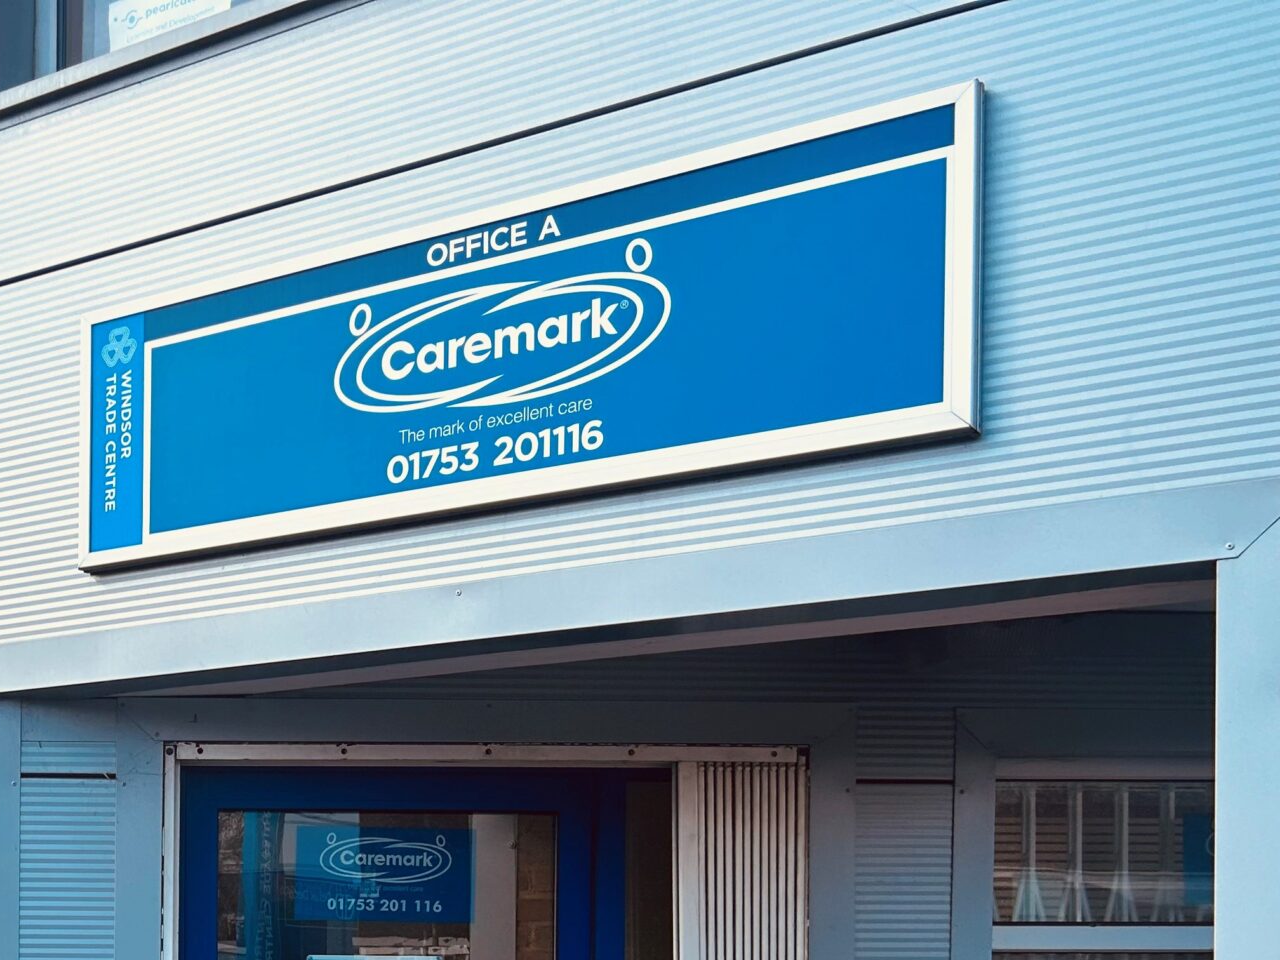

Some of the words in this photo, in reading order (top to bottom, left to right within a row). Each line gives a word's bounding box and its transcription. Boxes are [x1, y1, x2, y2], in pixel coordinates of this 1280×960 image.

[426, 221, 527, 266] OFFICE
[538, 214, 561, 241] A
[381, 297, 619, 381] Caremark
[105, 373, 117, 435] TRADE
[120, 369, 132, 459] WINDSOR
[399, 428, 425, 445] The
[429, 420, 465, 440] mark
[468, 415, 484, 432] of
[486, 404, 554, 428] excellent
[558, 398, 593, 415] care
[104, 440, 116, 512] CENTRE
[386, 441, 480, 484] 01753
[493, 419, 604, 467] 201116
[340, 850, 433, 867] Caremark
[327, 898, 375, 911] 01753
[380, 899, 407, 912] 201
[414, 900, 442, 913] 116
